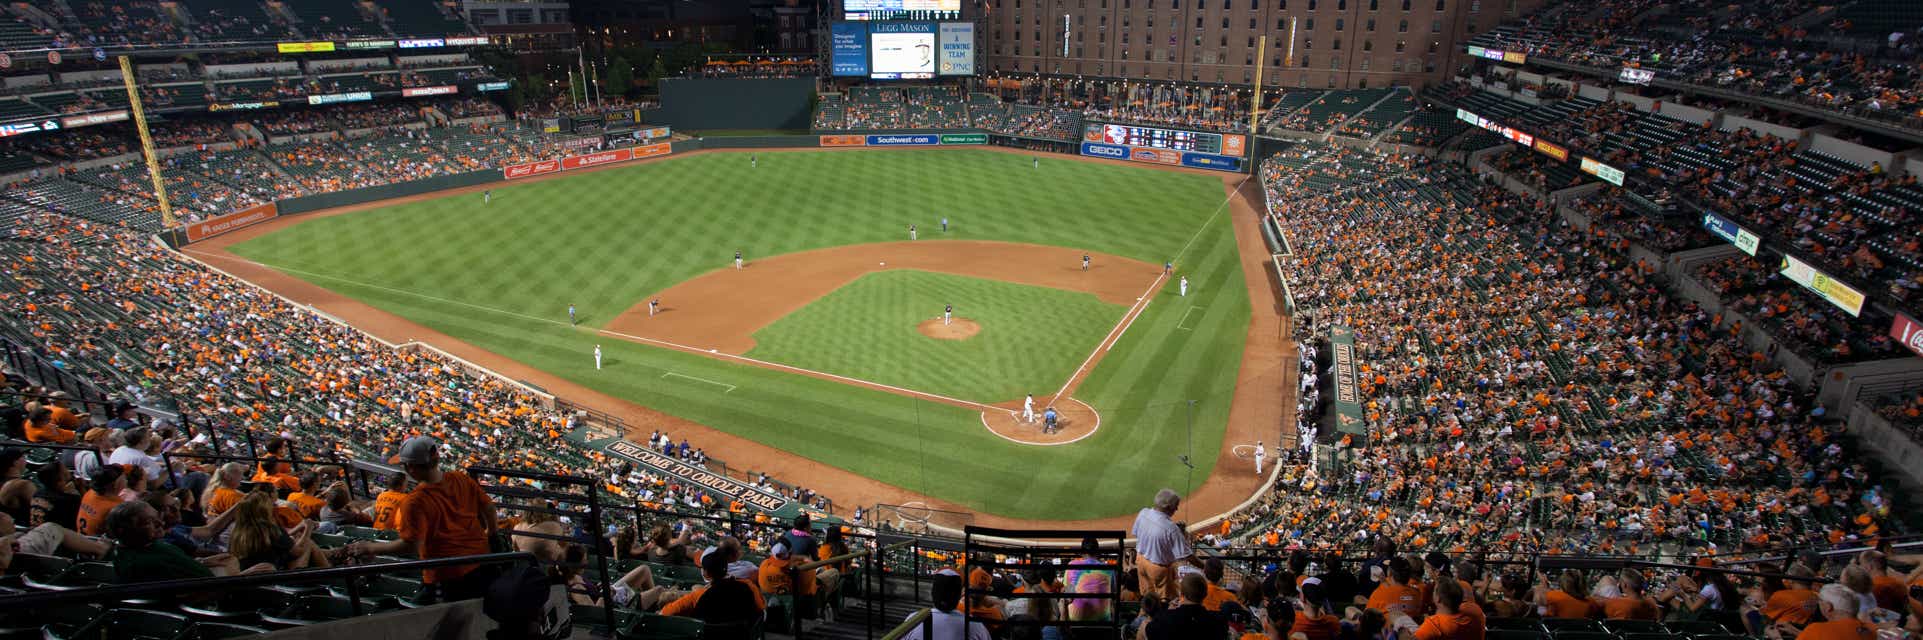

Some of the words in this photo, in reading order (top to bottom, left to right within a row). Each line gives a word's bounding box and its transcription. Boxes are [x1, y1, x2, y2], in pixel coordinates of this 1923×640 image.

[876, 24, 898, 32] LEGG
[900, 24, 930, 32] MASON
[953, 62, 971, 71] PNC
[1089, 145, 1123, 156] GEICO
[613, 442, 674, 470] WELCOME
[672, 464, 693, 477] TO
[691, 472, 744, 496] ORIOLE
[740, 489, 782, 510] PARK
